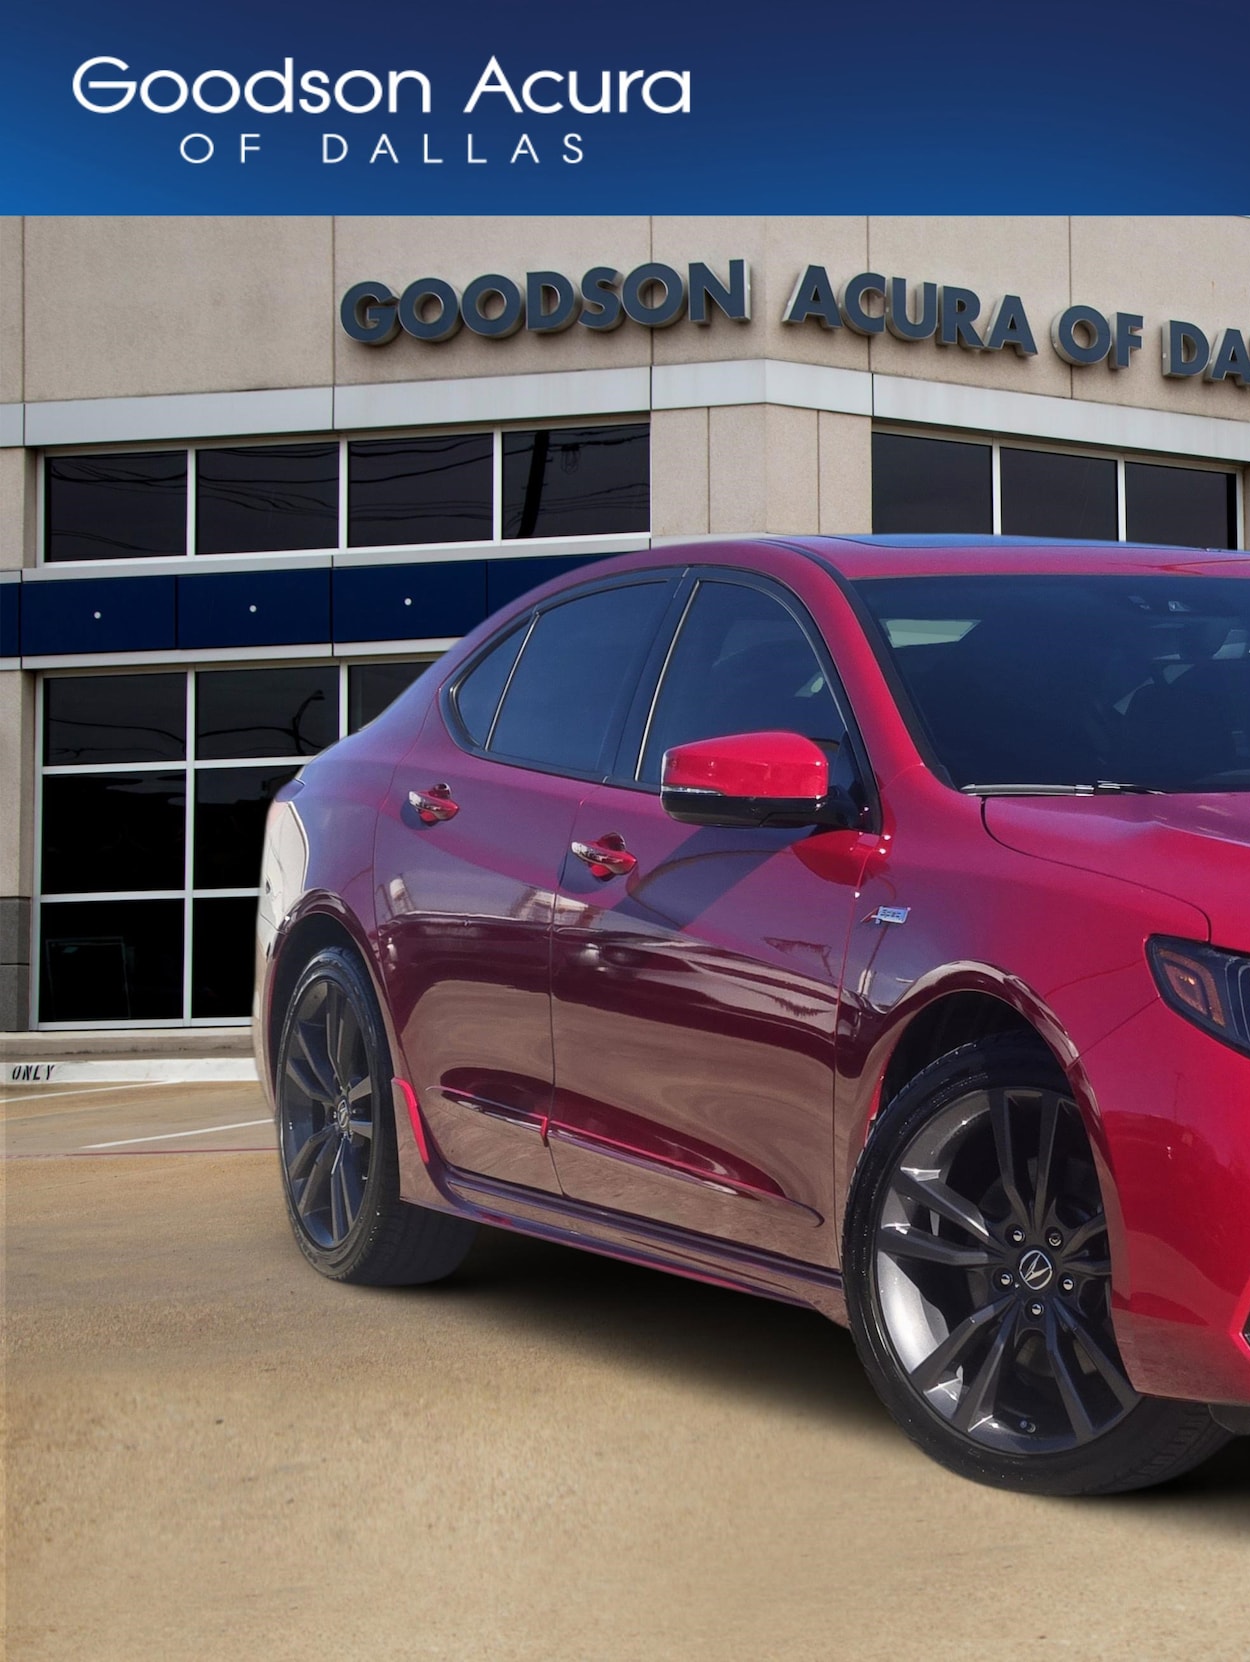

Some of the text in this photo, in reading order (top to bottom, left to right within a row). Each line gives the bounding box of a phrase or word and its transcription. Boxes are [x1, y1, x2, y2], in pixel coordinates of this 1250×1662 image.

[340, 258, 752, 348] GOODSON
[782, 264, 1039, 358] ACURA
[1051, 304, 1143, 370] OF
[12, 1064, 55, 1080] ONLY
